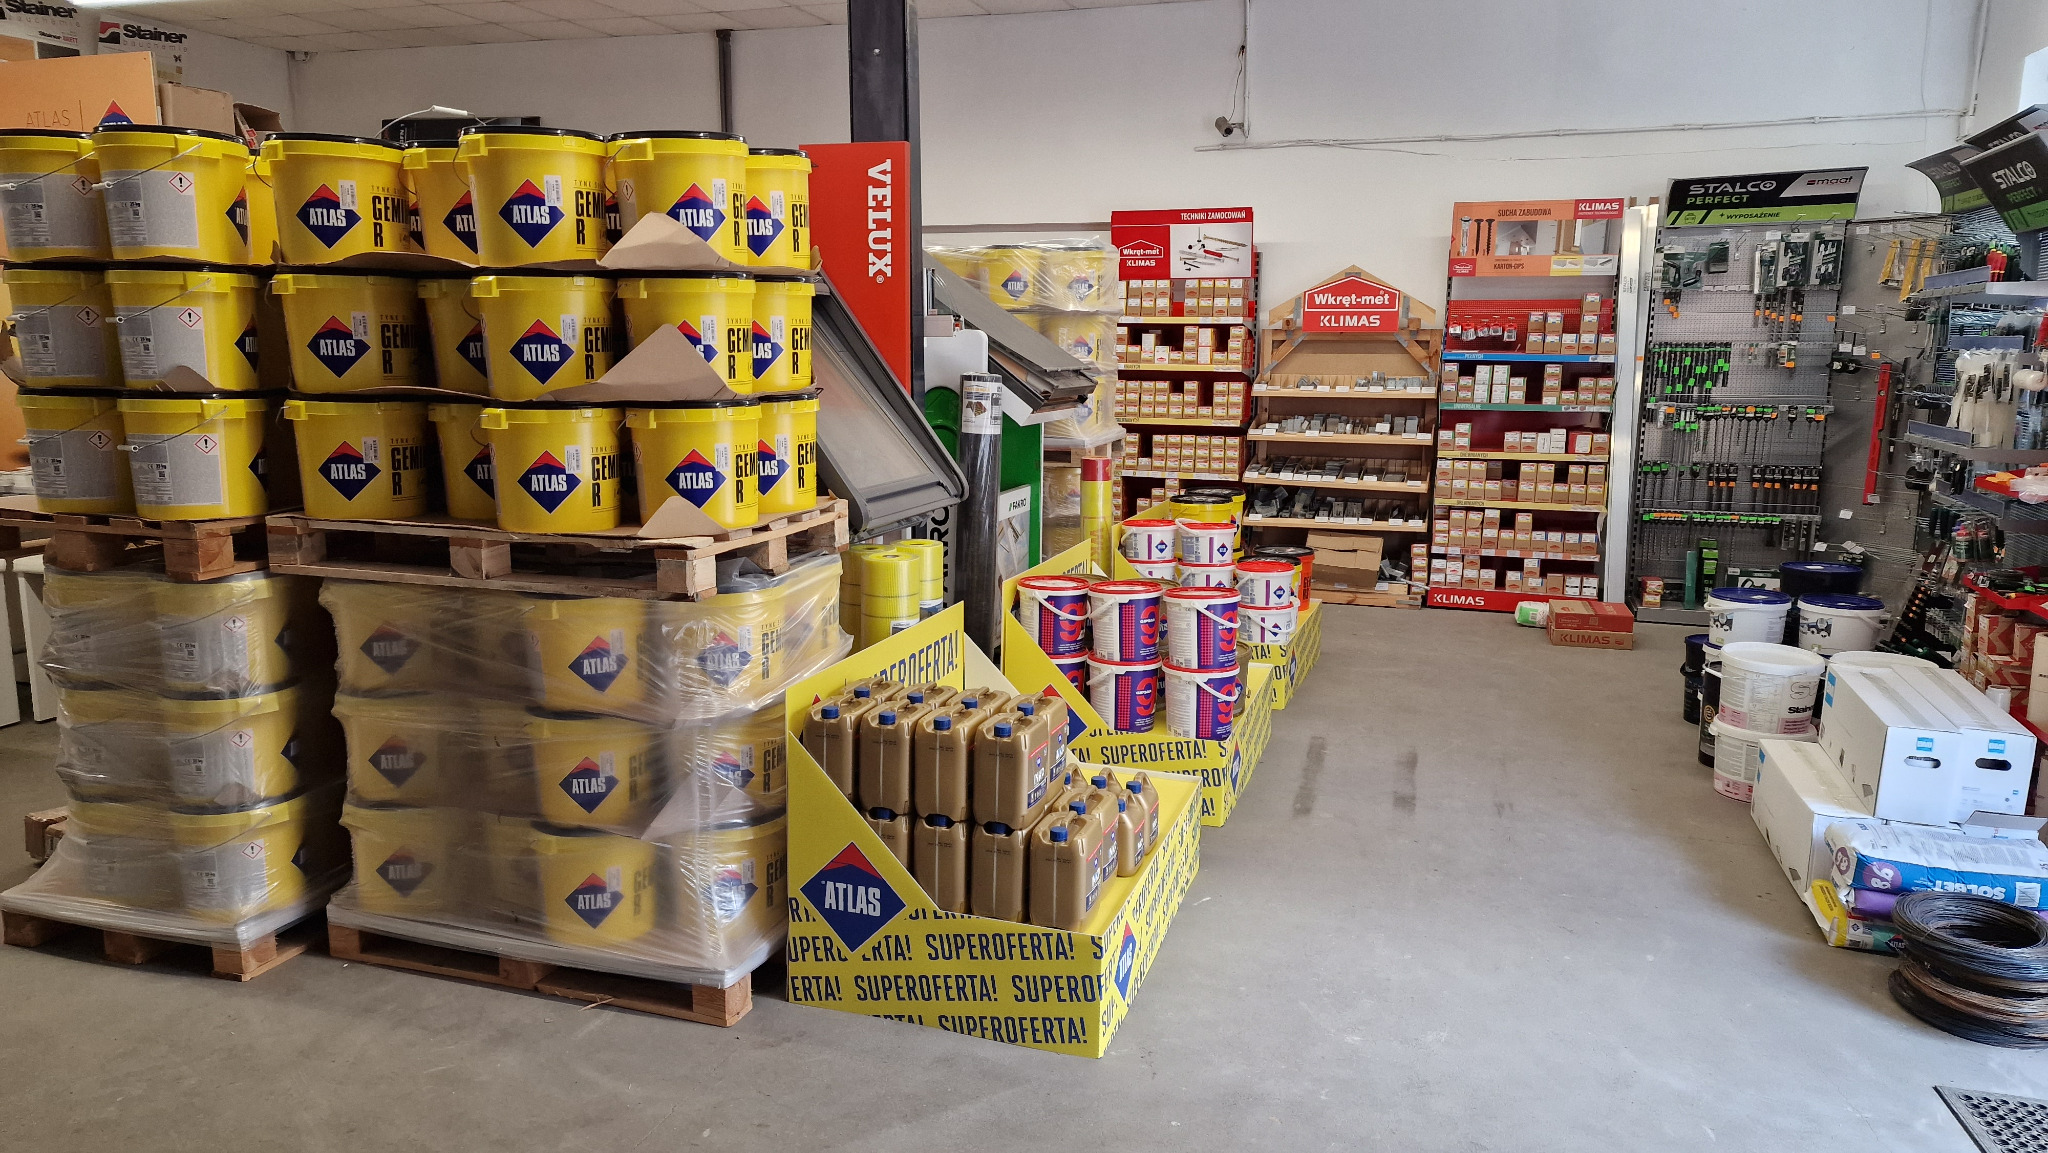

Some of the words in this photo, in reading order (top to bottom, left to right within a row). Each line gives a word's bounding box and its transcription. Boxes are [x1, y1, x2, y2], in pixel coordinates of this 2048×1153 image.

[5, 0, 78, 18] Stainer
[123, 24, 187, 44] Stainer
[26, 109, 71, 127] ATLAS
[1991, 160, 2037, 190] STALCO
[1688, 180, 1777, 195] STALCO
[1578, 202, 1620, 211] KLIMAS
[1685, 194, 1750, 206] PERFECT
[309, 207, 346, 227] ATLAS
[512, 206, 550, 225] ATLAS
[678, 208, 714, 227] ATLAS
[867, 158, 892, 278] VELUX
[1180, 212, 1207, 221] TECHNIKI
[1207, 209, 1247, 220] ZAMOCOWAŃ
[1497, 208, 1517, 218] SUCHA
[1518, 207, 1552, 217] ZABUDOWA
[1726, 211, 1781, 220] WYPOSAŻENIE
[373, 222, 384, 247] R
[576, 218, 586, 245] R
[734, 220, 741, 247] R
[793, 228, 800, 253] R
[1126, 259, 1156, 267] KLIMAS
[1493, 262, 1525, 270] KARTON-GIPS
[1007, 281, 1025, 291] ATLAS
[1313, 292, 1390, 309] Wkręt-met
[1320, 315, 1381, 327] KLIMAS
[319, 339, 356, 357] ATLAS
[523, 343, 560, 362] ATLAS
[752, 342, 772, 359] LAS
[382, 349, 393, 375] R
[584, 353, 595, 380] R
[728, 354, 736, 380] R
[792, 351, 799, 375] R
[330, 463, 366, 480] ATLAS
[759, 459, 779, 477] LAS
[797, 466, 805, 489] R
[391, 471, 402, 496] R
[531, 474, 567, 492] ATLAS
[678, 471, 714, 490] ATLAS
[591, 482, 601, 508] R
[735, 479, 744, 504] R
[1012, 498, 1027, 511] FAKRO
[1434, 593, 1485, 606] KLIMAS
[1560, 633, 1611, 646] KLIMAS
[583, 656, 617, 676] ATLAS
[1100, 739, 1207, 765] SUPEROFERTA!
[572, 776, 606, 795] ATLAS
[577, 893, 611, 910] ATLAS
[824, 880, 881, 917] ATLAS
[926, 932, 1075, 962] SUPEROFERTA!
[854, 974, 998, 1002] SUPEROFERTA!
[938, 1014, 1088, 1045] SUPEROFERTA!
